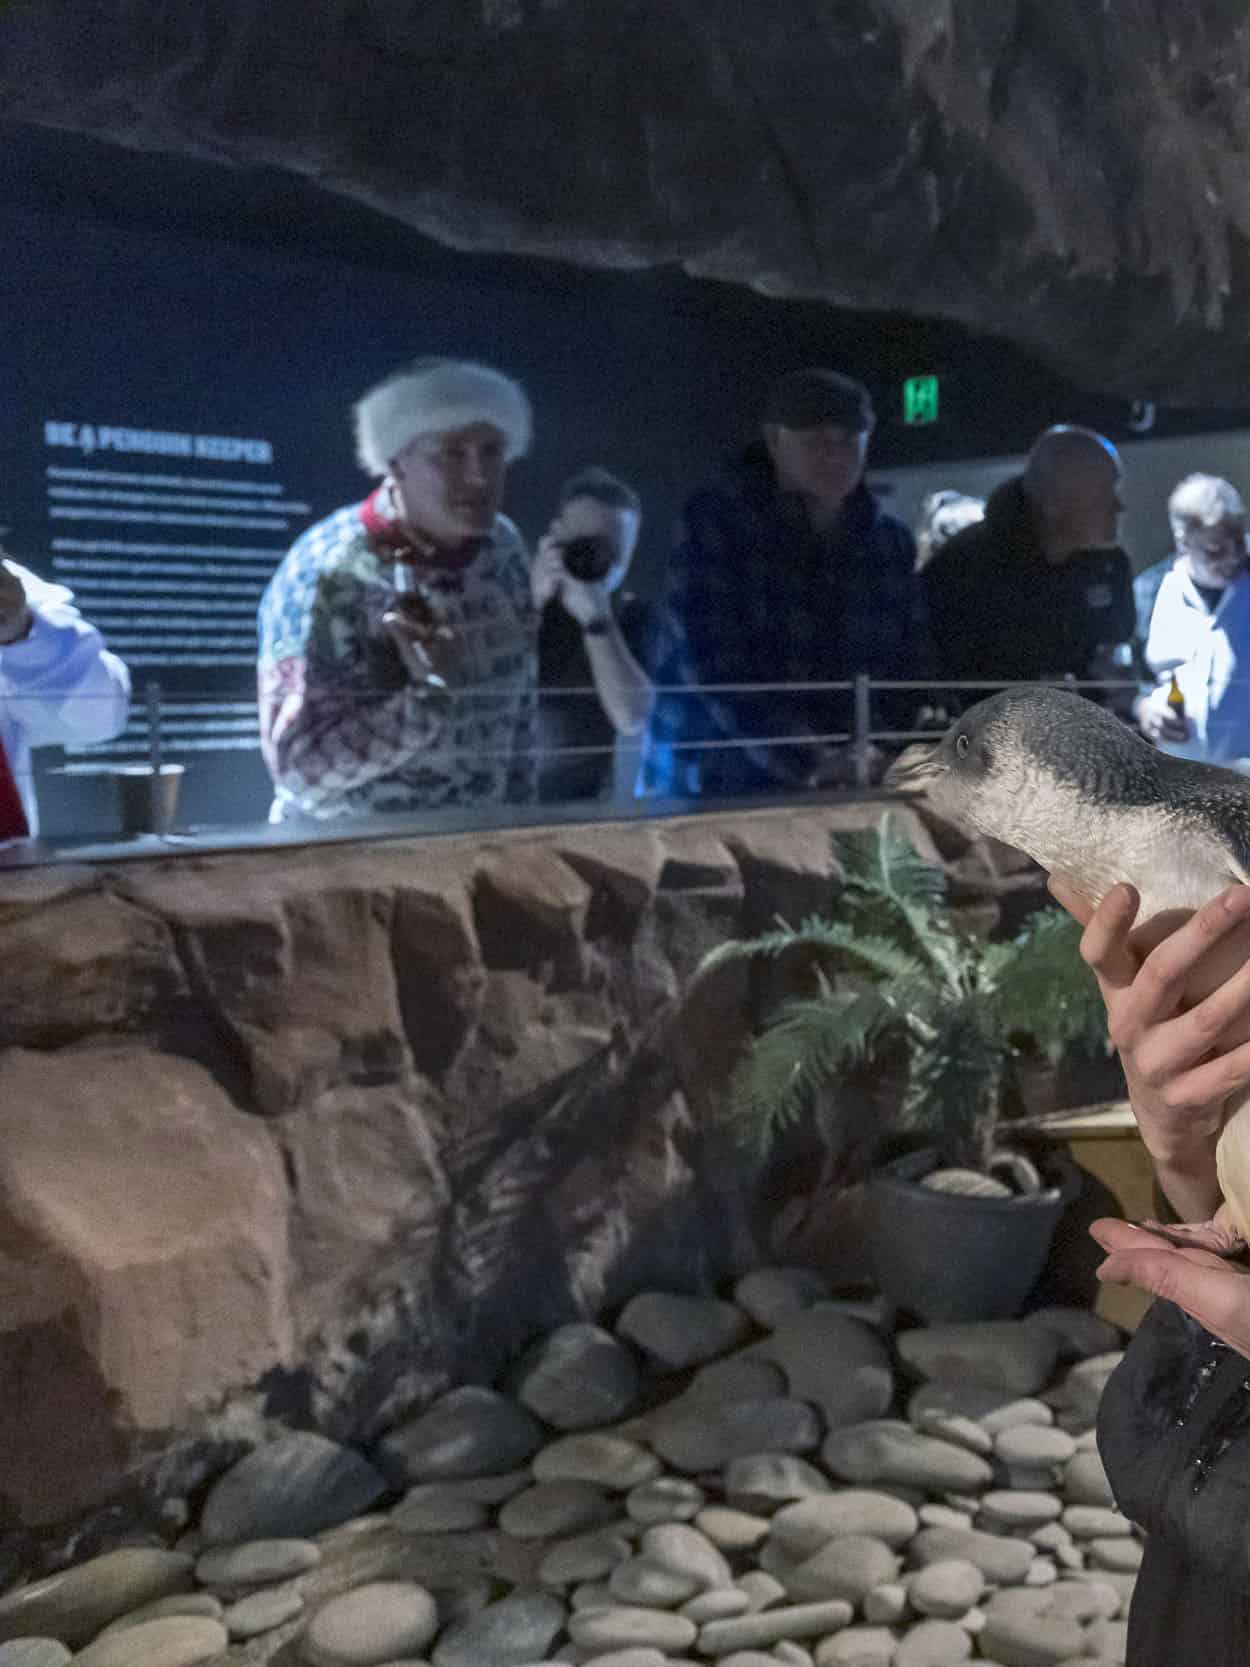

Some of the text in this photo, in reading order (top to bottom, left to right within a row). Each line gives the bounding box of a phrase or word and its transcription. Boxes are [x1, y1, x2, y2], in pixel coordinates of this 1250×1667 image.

[44, 421, 76, 447] BE
[98, 426, 192, 456] PENGUIN
[195, 434, 273, 463] KEEPER
